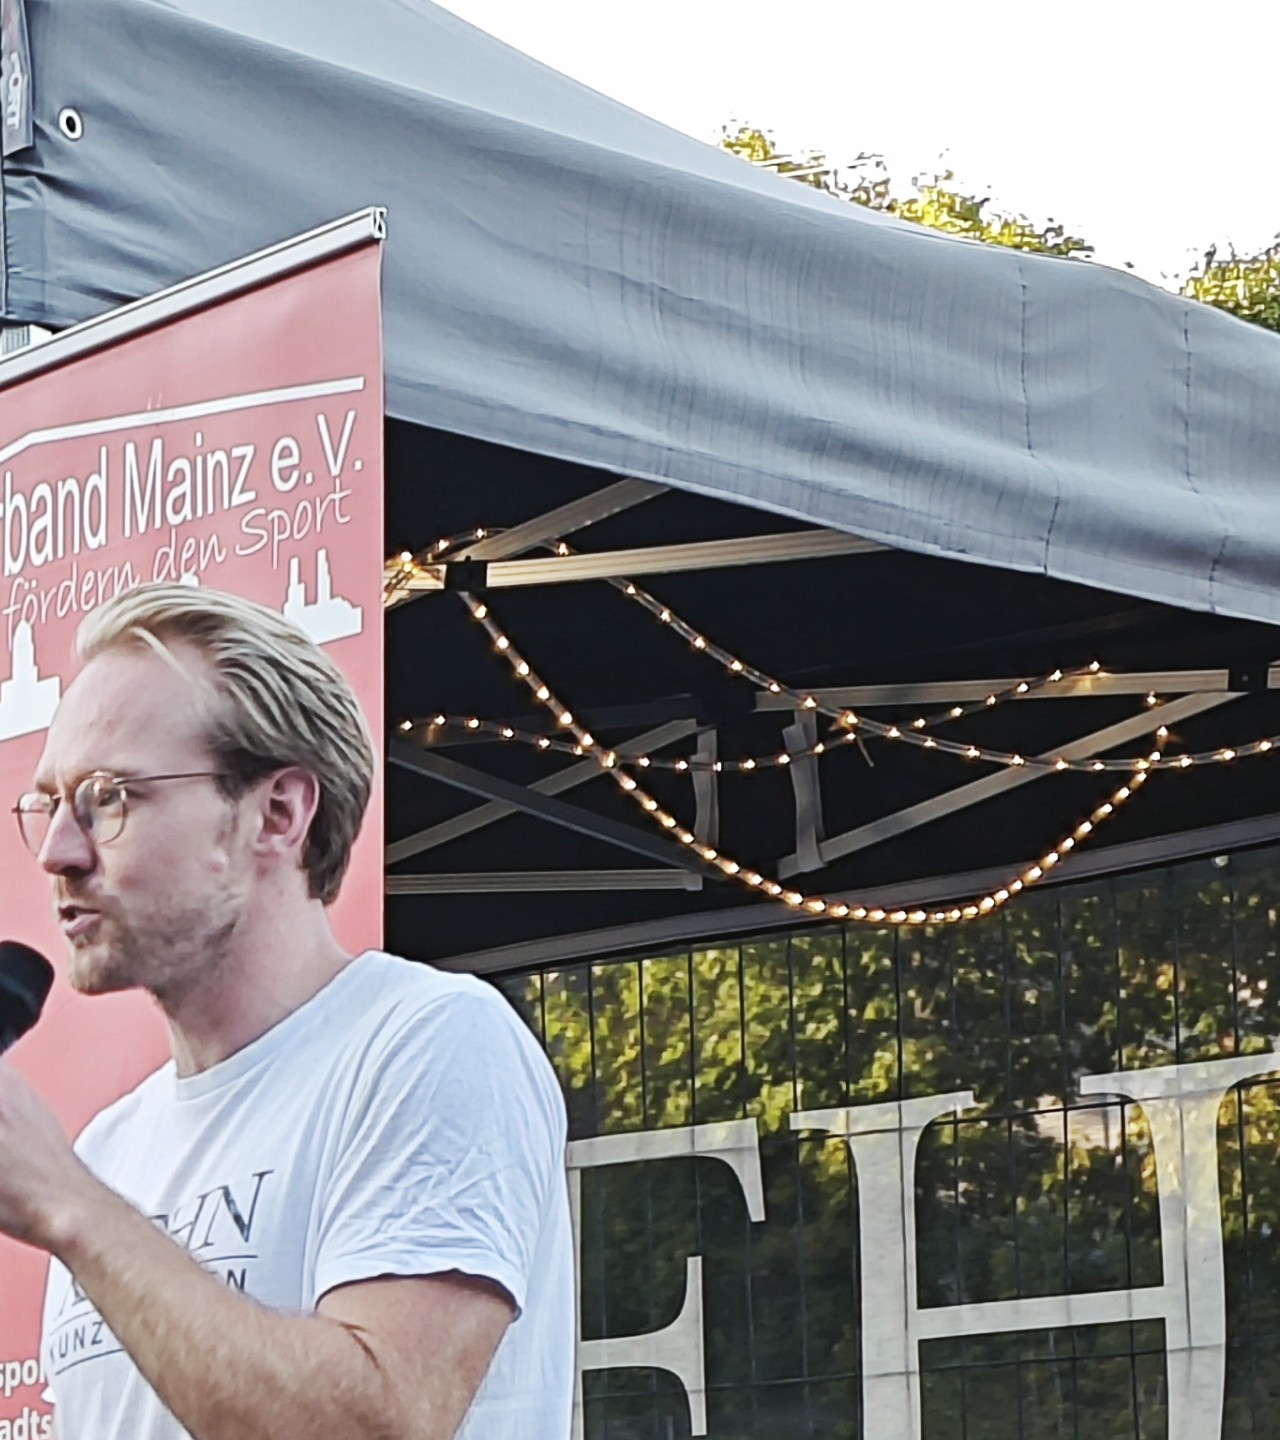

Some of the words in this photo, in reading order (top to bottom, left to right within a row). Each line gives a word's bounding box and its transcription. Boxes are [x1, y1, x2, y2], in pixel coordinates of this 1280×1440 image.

[124, 432, 257, 538] Mainz
[3, 560, 140, 651] fördern
[152, 527, 228, 582] den
[235, 482, 352, 569] Sport
